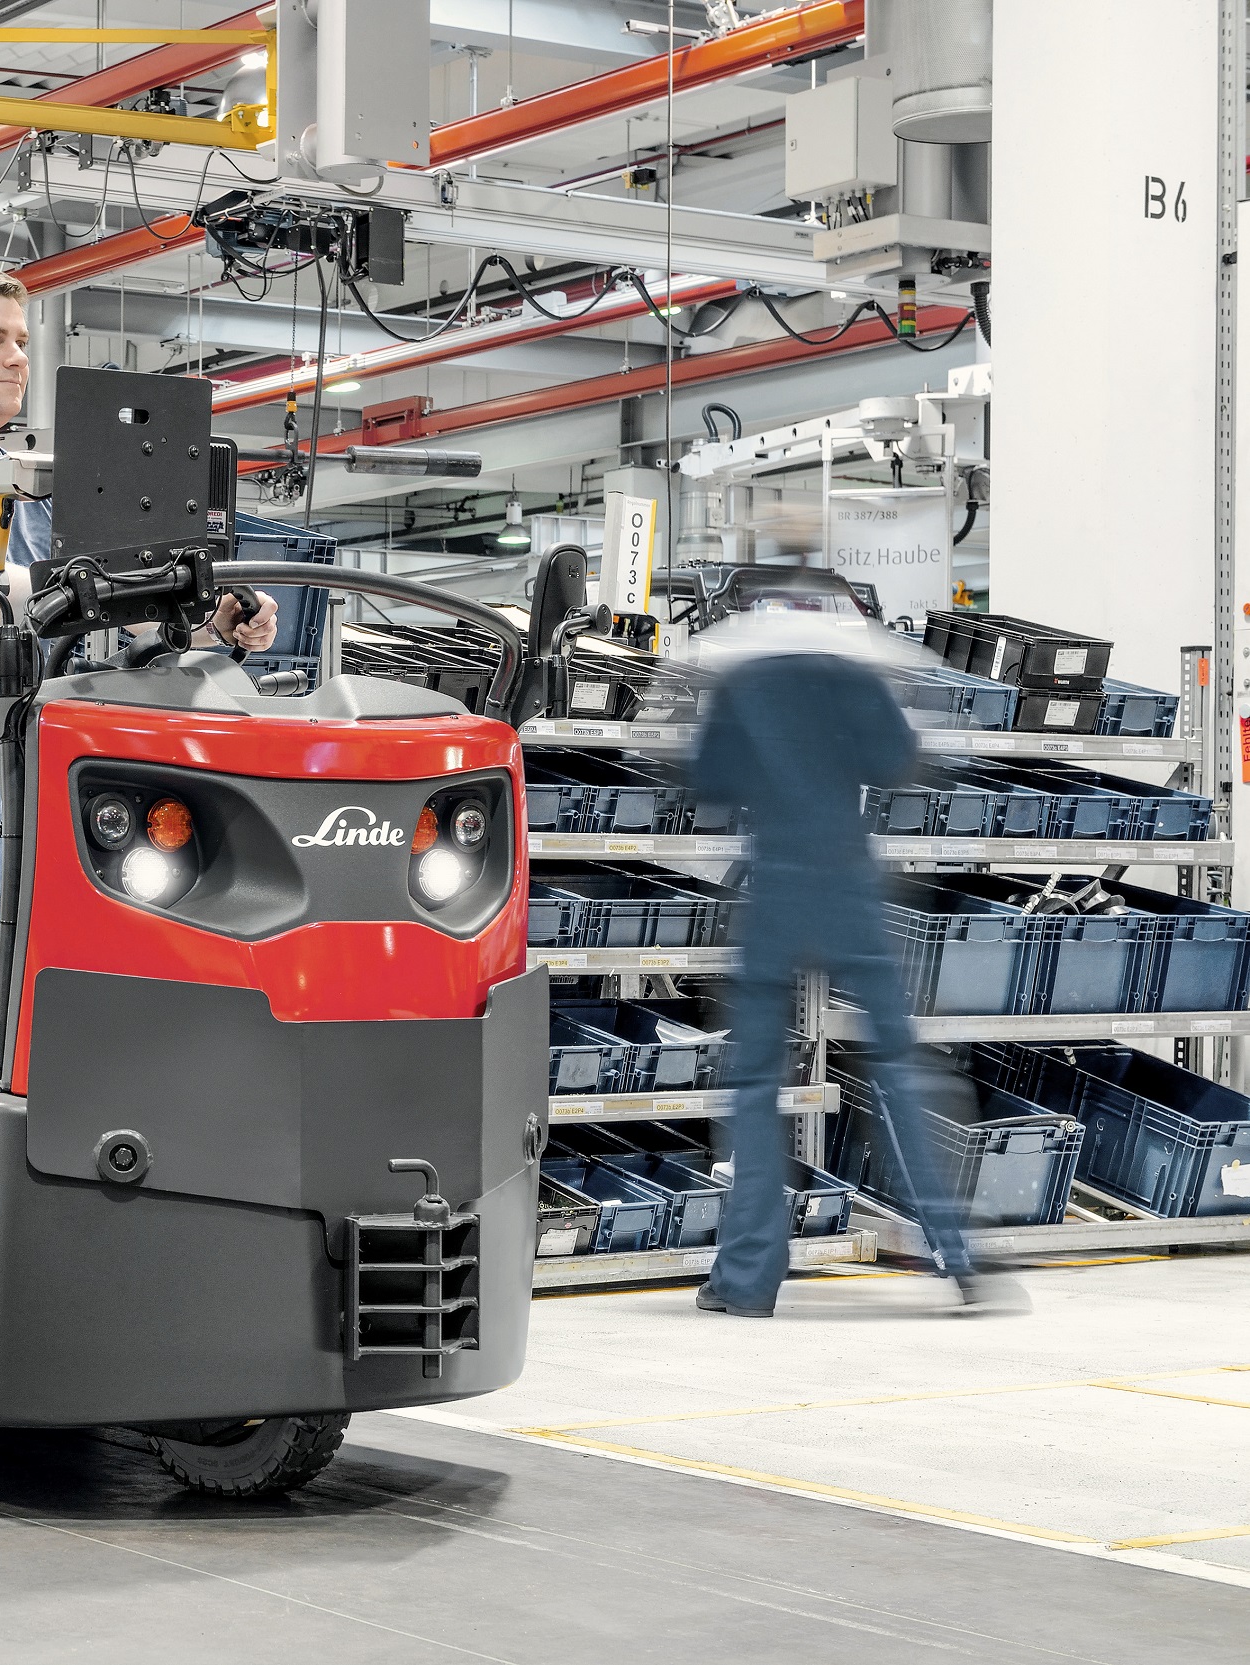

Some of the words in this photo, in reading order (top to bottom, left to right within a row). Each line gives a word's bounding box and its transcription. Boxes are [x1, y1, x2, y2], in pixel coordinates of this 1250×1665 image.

[838, 512, 850, 520] BR
[854, 510, 898, 521] 387/388
[910, 600, 928, 609] Takt
[932, 600, 938, 608] 5
[291, 805, 406, 848] Linde
